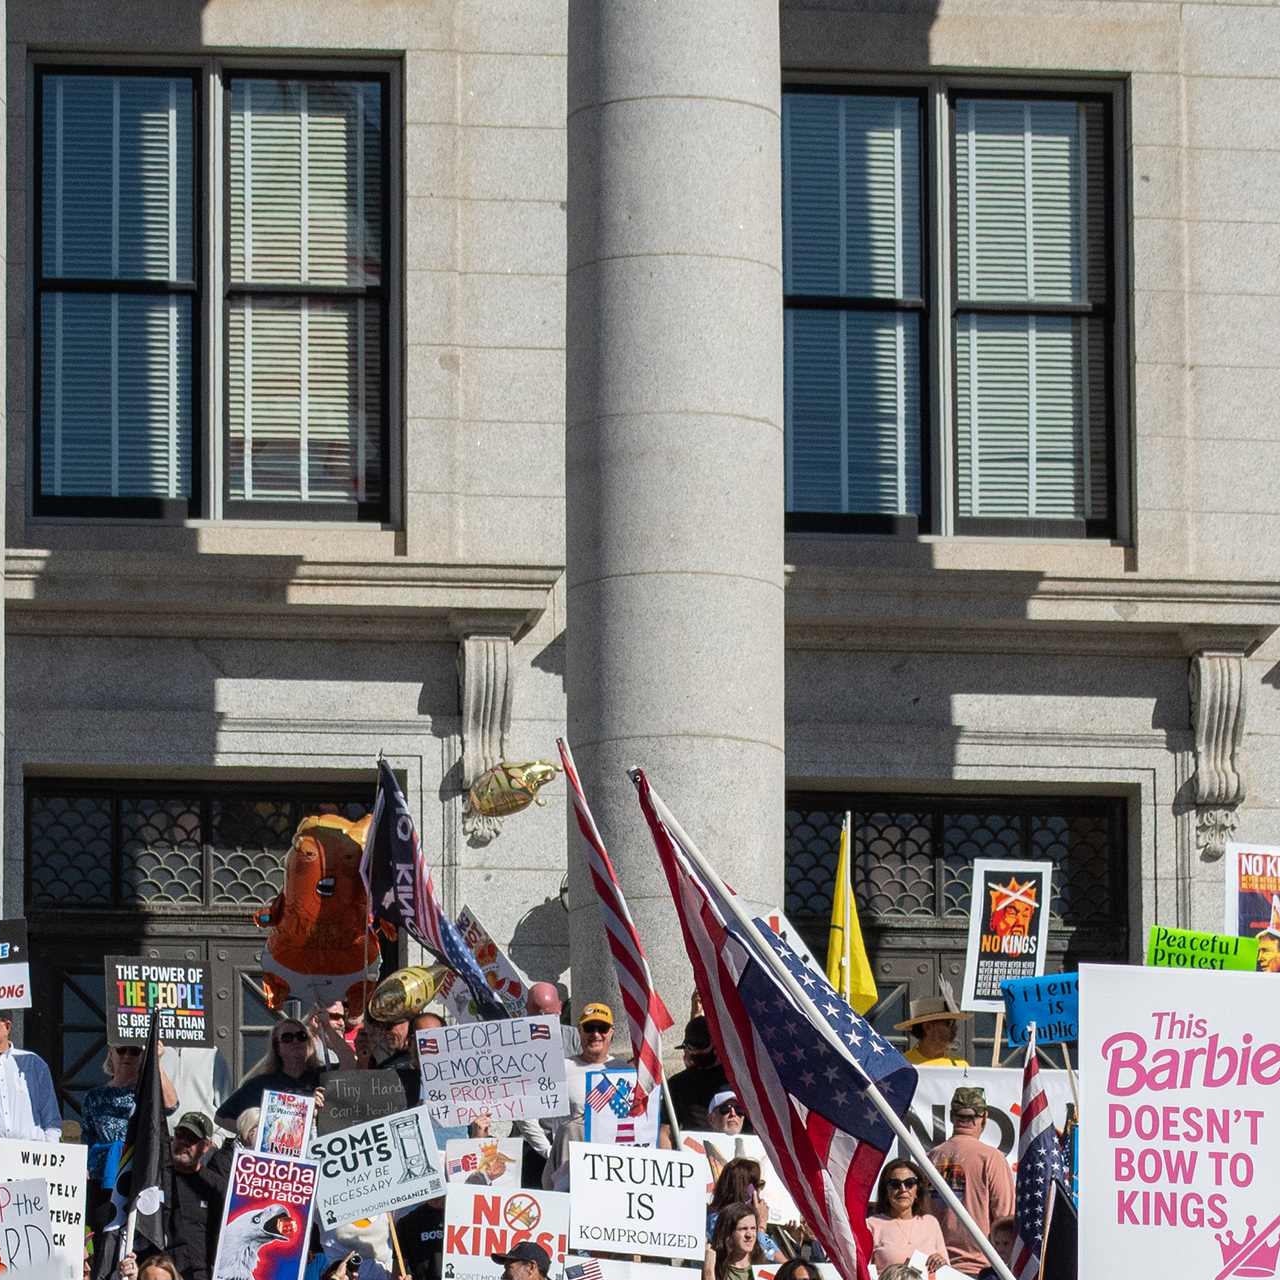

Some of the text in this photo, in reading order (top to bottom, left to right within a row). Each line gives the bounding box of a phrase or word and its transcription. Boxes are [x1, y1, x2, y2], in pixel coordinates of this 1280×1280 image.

[1241, 855, 1263, 876] NO
[982, 935, 1036, 954] NO KINGS
[1156, 928, 1239, 955] Peaceful
[1154, 948, 1224, 969] Protest
[116, 965, 203, 983] THE POWER OF
[117, 981, 204, 1009] THE PEOPLE
[118, 1014, 205, 1029] IS THAN
[118, 1027, 205, 1040] THE POWER.
[1152, 1011, 1207, 1040] This
[445, 1019, 527, 1052] PEOPLE
[423, 1052, 547, 1082] DEMOCRACY
[329, 1078, 361, 1102] Tiny
[450, 1079, 530, 1104] PROFIT
[472, 1076, 499, 1085] OVER
[1109, 1104, 1264, 1145] DOESN'T
[311, 1123, 387, 1159] SOME
[21, 1152, 65, 1167] WWJD?
[238, 1155, 314, 1184] Gotcha
[323, 1143, 392, 1178] CUTS
[583, 1153, 694, 1189] TRUMP
[1115, 1148, 1253, 1188] BOW TO
[236, 1172, 313, 1194] Wannabe
[346, 1165, 390, 1187] MAY BE
[13, 1194, 43, 1216] the
[324, 1177, 392, 1208] NECESSARY
[362, 1188, 429, 1214] MOURN ORGANIZE
[626, 1192, 654, 1220] IS
[1118, 1190, 1227, 1229] KINGS
[579, 1226, 698, 1249] KOMPROMIZED
